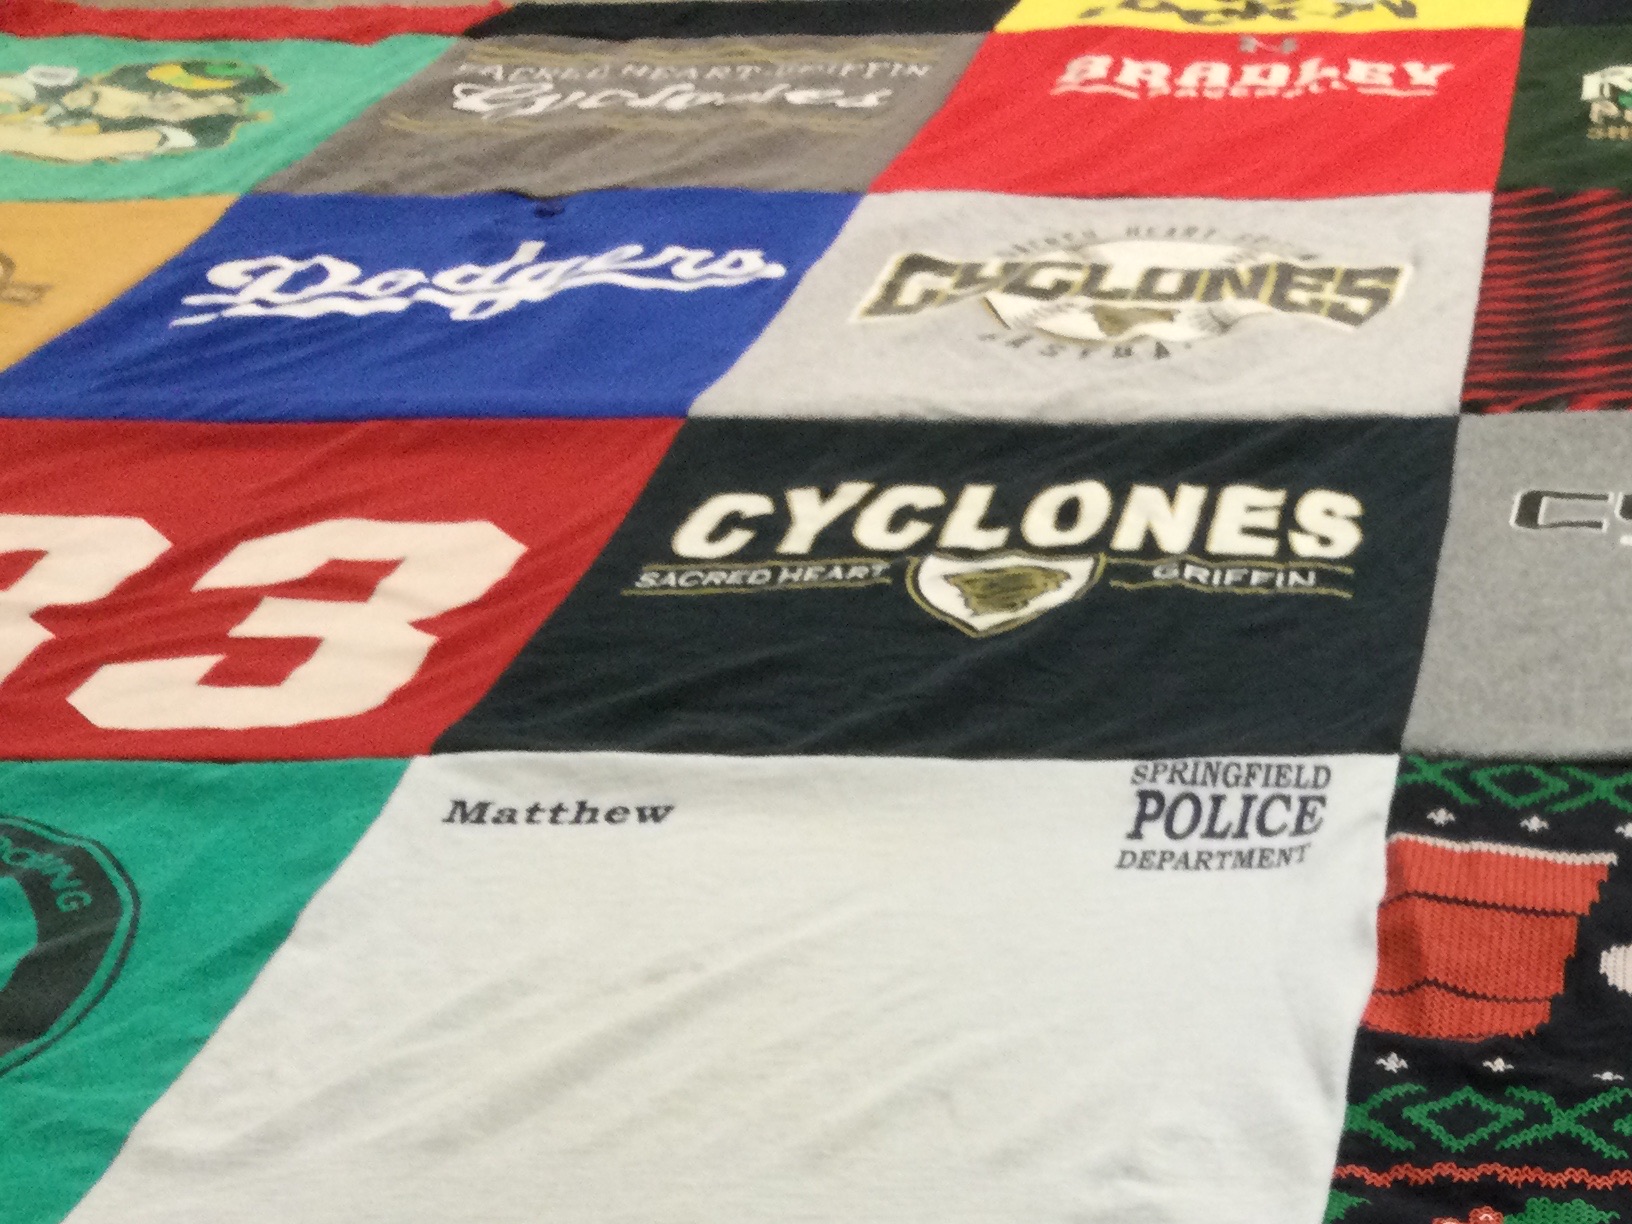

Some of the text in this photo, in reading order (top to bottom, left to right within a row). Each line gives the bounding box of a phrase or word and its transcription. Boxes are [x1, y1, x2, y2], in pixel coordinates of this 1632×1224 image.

[170, 240, 787, 326] Dodgers
[860, 255, 1412, 333] CYCLONES
[671, 479, 1365, 559] CYCLONES
[634, 563, 1317, 588] SACRED HEART GRIFFIN
[1130, 760, 1333, 790] SPRINGFIELD
[441, 799, 675, 826] Matthew
[1125, 789, 1328, 841] POLICE
[1114, 842, 1313, 872] DEPARTMENT
